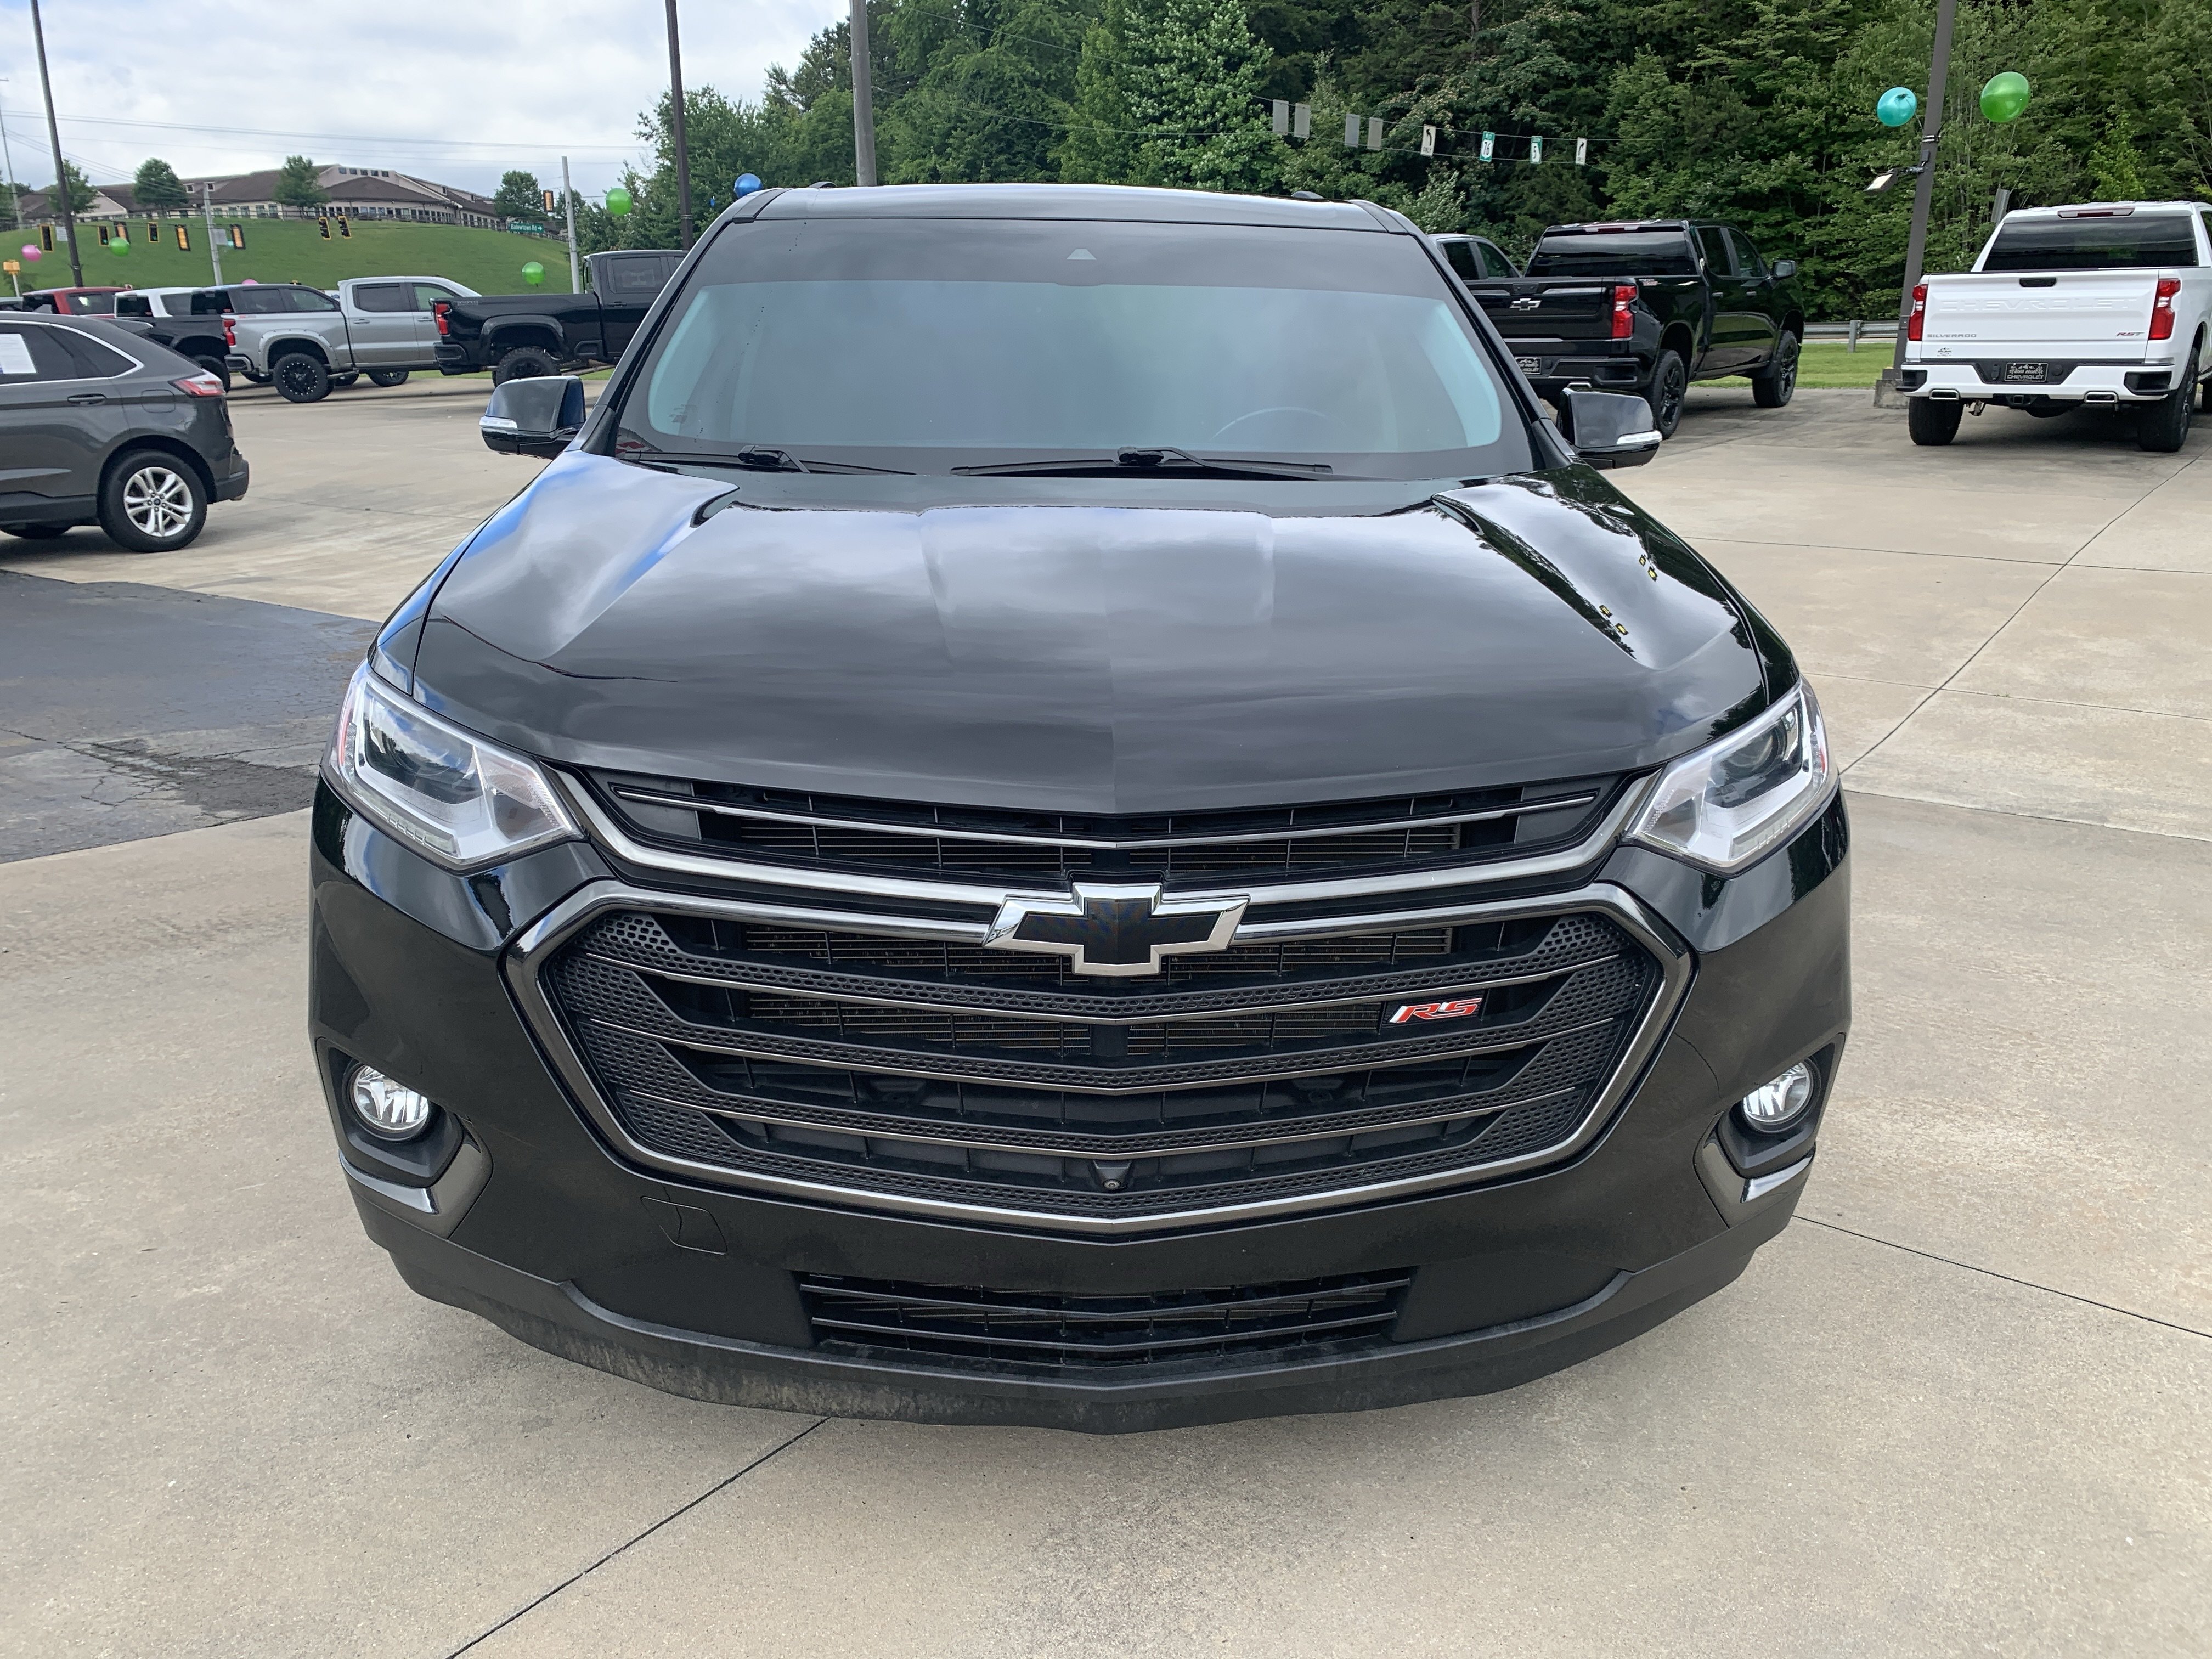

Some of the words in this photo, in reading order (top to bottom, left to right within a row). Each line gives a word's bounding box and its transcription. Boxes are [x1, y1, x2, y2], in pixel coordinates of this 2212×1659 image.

[1483, 142, 1491, 156] 76
[1533, 146, 1537, 159] 5
[1939, 298, 2138, 312] CHEVROLET
[1389, 997, 1482, 1023] RS
